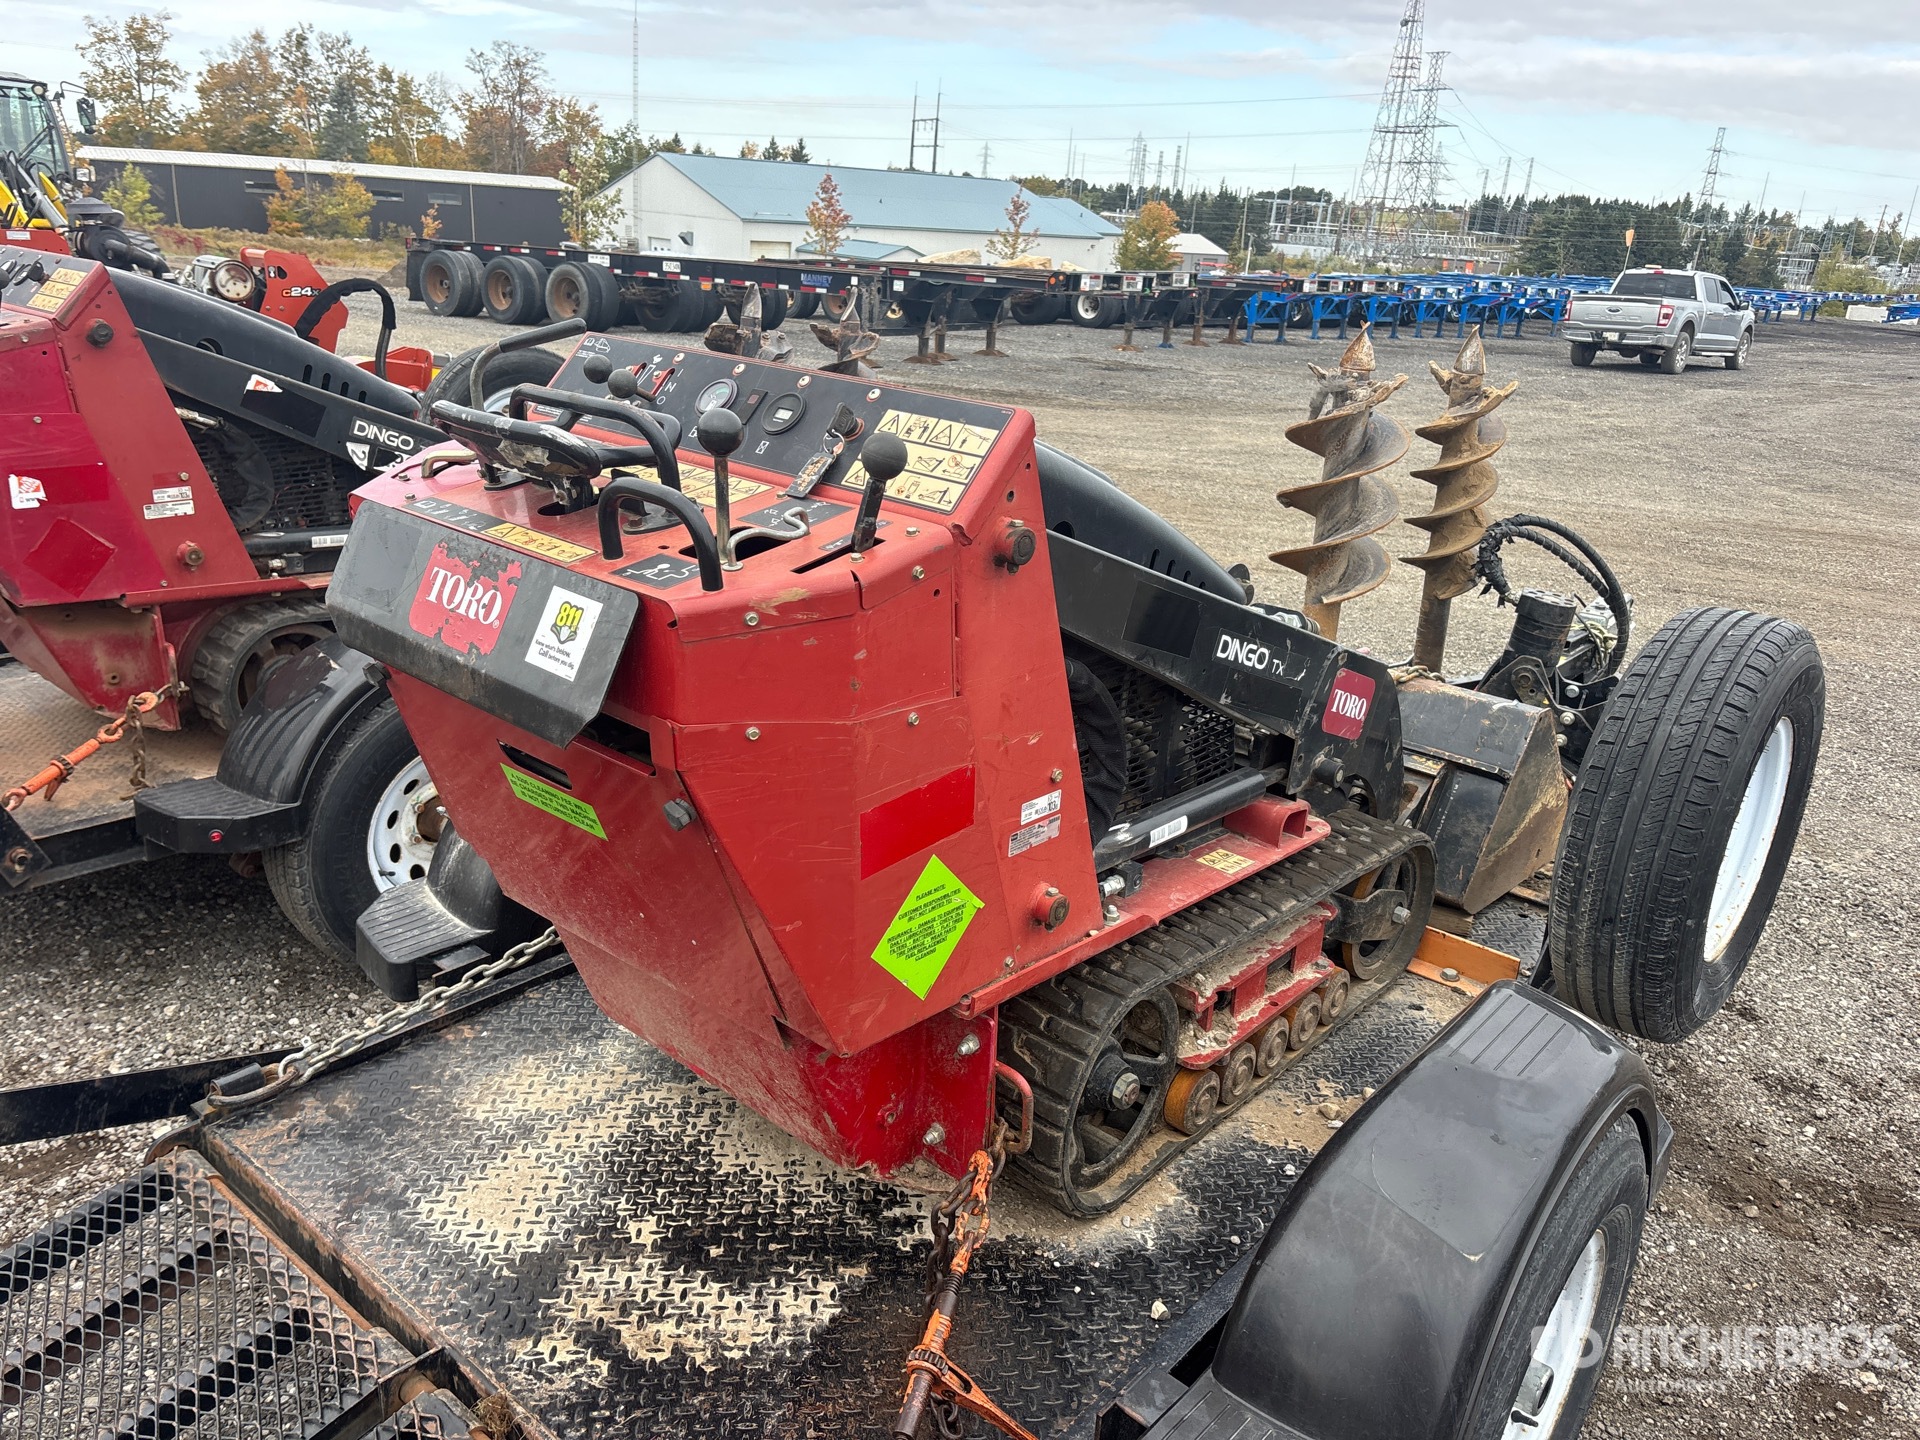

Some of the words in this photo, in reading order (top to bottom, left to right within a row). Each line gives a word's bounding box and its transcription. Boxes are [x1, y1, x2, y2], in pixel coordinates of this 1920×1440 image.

[353, 419, 414, 451] DINGO
[425, 566, 503, 625] TORO
[556, 602, 584, 632] 811
[538, 648, 549, 658] Call
[1216, 634, 1270, 669] DINGO
[1331, 689, 1367, 720] TORO
[519, 783, 547, 800] CHARGED
[569, 806, 599, 826] MACHINE
[528, 793, 540, 804] NOT
[540, 798, 574, 819] RETURNED
[573, 815, 596, 831] CLEAN
[529, 781, 560, 800] CLEANING
[560, 796, 574, 808] FEE
[574, 803, 590, 815] WILL
[916, 889, 934, 902] PLEASE
[919, 909, 929, 919] NOT
[928, 901, 946, 914] LIMITED
[887, 927, 913, 944] INSURANCE
[917, 916, 939, 931] DAMAGE
[944, 902, 967, 918] EQUIPMENT
[898, 905, 923, 920] CUSTOMER
[889, 938, 903, 949] DAILY
[939, 914, 954, 926] CHECK
[889, 941, 907, 955] FILTERS
[912, 930, 936, 946] BATTERIES
[940, 921, 952, 932] FLAT
[906, 940, 926, 955] DAMAGE
[930, 931, 942, 942] WEAR
[942, 925, 957, 938] PARTS
[905, 949, 918, 960] FUEL
[918, 936, 948, 955] REPLACEMENT
[915, 947, 937, 962] CLEANING
